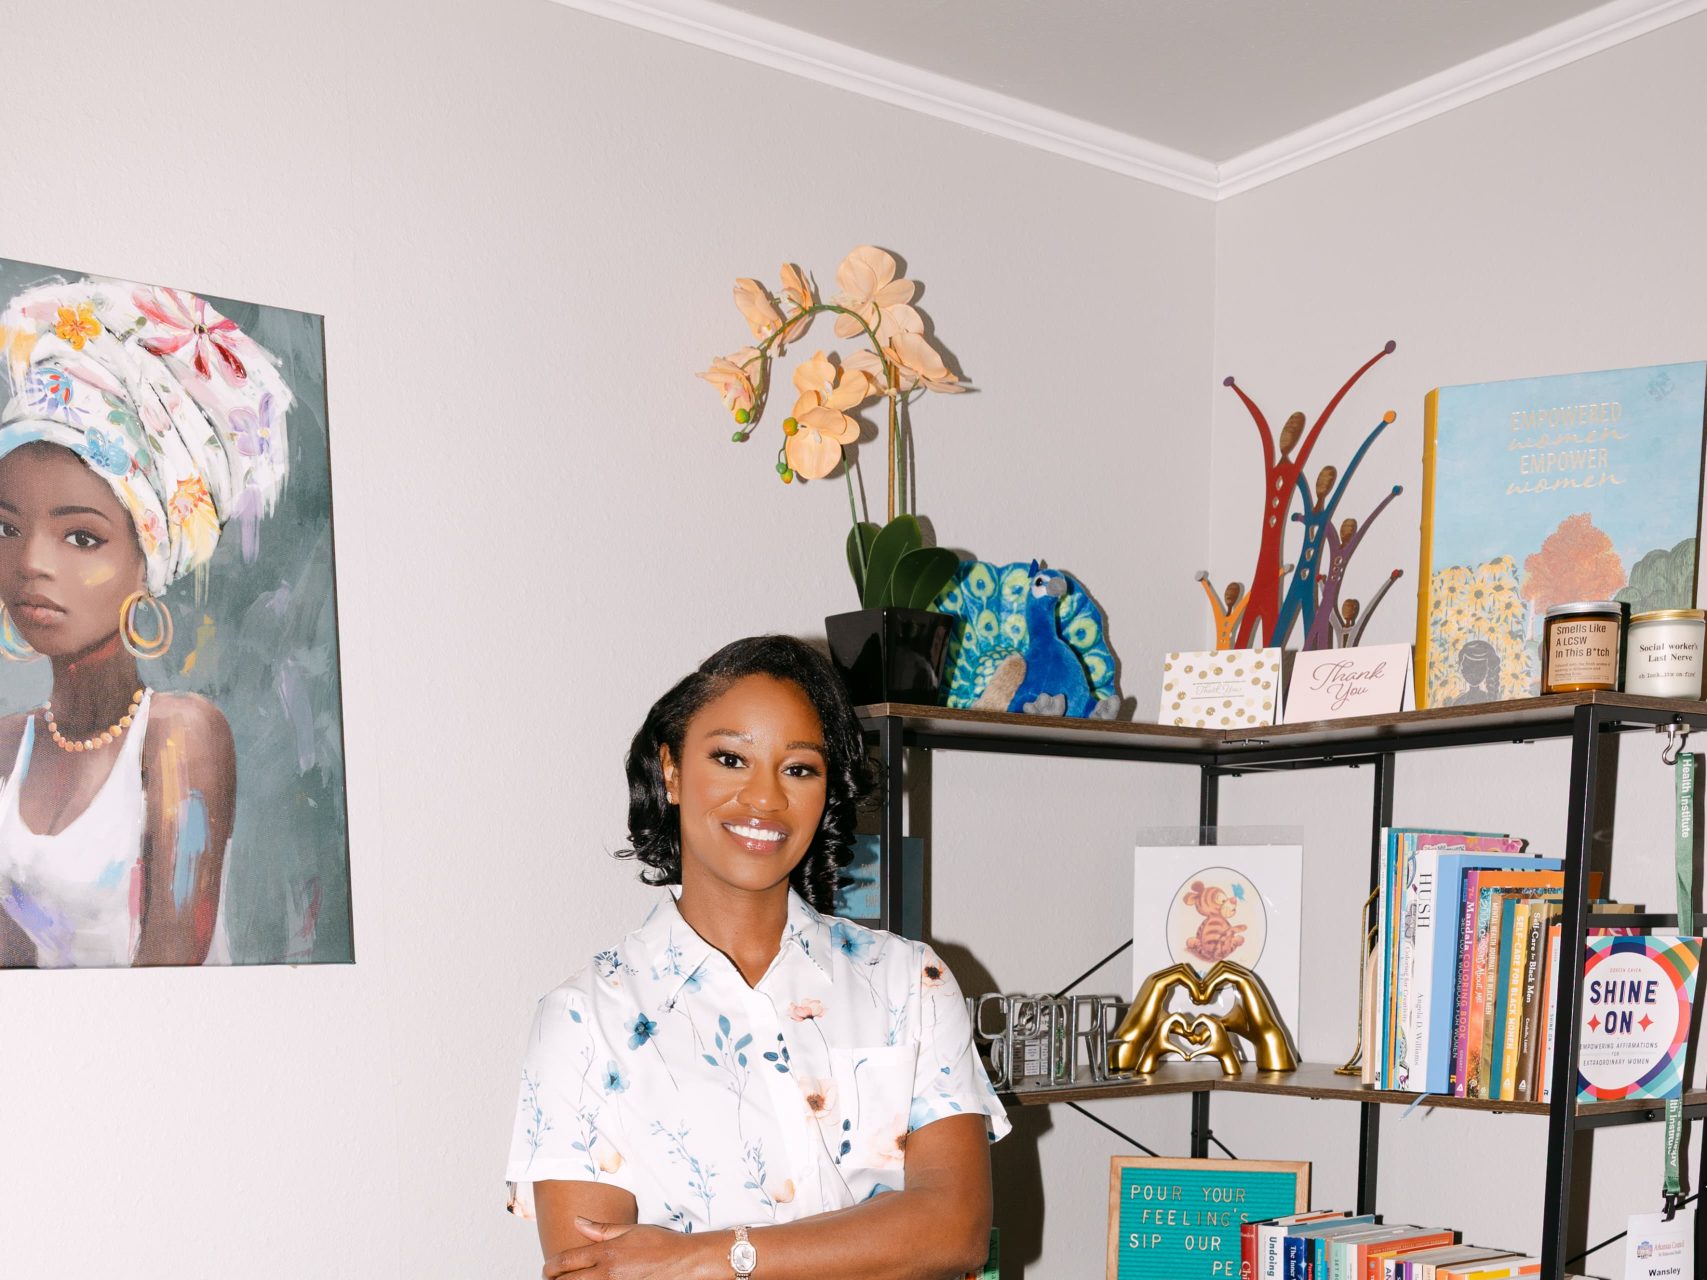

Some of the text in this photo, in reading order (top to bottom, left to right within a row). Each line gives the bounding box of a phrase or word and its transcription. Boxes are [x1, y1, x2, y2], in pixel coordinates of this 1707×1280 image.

[1510, 401, 1622, 431] EMPOWERED
[1507, 429, 1628, 452] women
[1520, 449, 1608, 475] EMPOWER
[1507, 474, 1625, 495] women
[1557, 624, 1606, 635] Smells Like
[1563, 636, 1587, 645] LCSW
[1556, 650, 1563, 658] In
[1566, 649, 1584, 657] This
[1640, 643, 1664, 652] Social
[1648, 654, 1666, 662] Last
[1311, 659, 1386, 691] Thank
[1326, 683, 1368, 711] You
[1680, 759, 1692, 838] Health Institute
[1417, 873, 1433, 928] HUSH
[1463, 901, 1475, 951] Mandala
[1513, 916, 1524, 966] SELF-CARE
[1485, 902, 1499, 1015] MENTAL HEALTH JOURNAL FOR BLACK MEN
[1526, 912, 1541, 1003] Self-Care Black Men
[1401, 946, 1411, 1024] Coloring Creativity
[1460, 953, 1471, 1007] COLORING
[1475, 965, 1486, 991] About
[1511, 968, 1521, 985] FOR
[1509, 987, 1520, 1015] BLACK
[1590, 980, 1659, 1004] SHINE
[1414, 992, 1425, 1066] Angela Williams
[1459, 1010, 1467, 1040] BOOK
[1505, 1017, 1517, 1049] WOMEN
[1604, 1010, 1634, 1034] ON
[966, 992, 1138, 1092] SPIRE
[1452, 1028, 1460, 1058] WOMEN
[1130, 1184, 1246, 1203] POUR YOUR
[1129, 1233, 1221, 1251] SIP OUR
[1267, 1236, 1277, 1277] Undoing
[1648, 1267, 1680, 1276] Wansley
